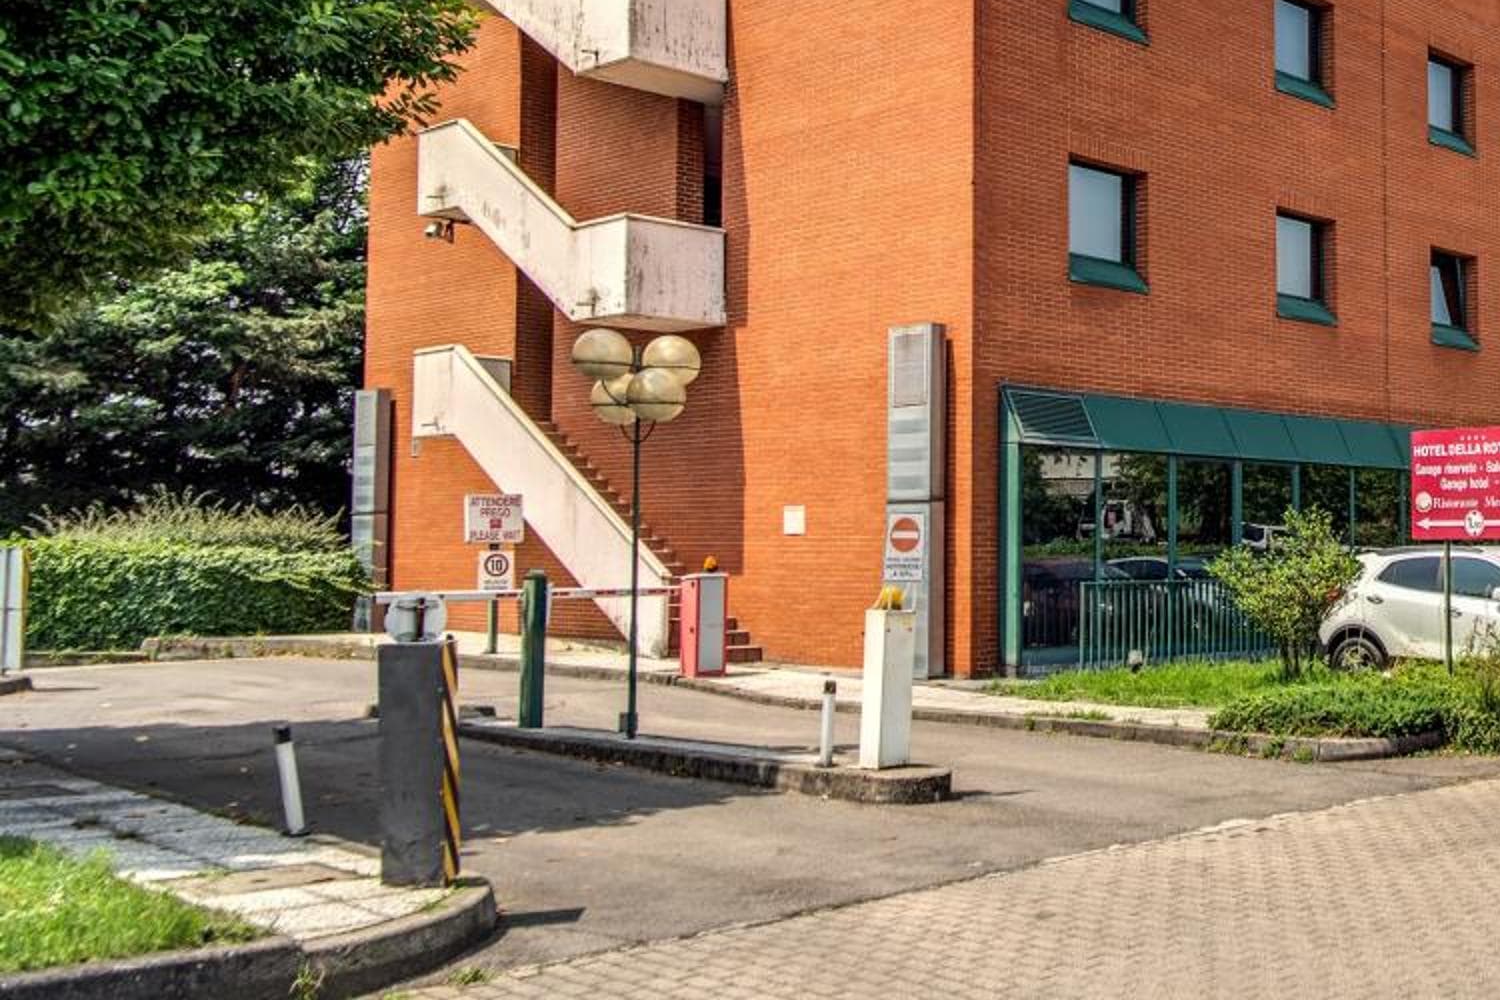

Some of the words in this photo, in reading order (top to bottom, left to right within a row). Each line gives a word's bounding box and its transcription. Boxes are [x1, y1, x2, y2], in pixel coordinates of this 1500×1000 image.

[1413, 443, 1447, 457] HOTEL
[1448, 442, 1481, 455] DELLA
[1470, 477, 1489, 488] hotel
[470, 495, 522, 507] ATTENDERE
[1433, 497, 1478, 509] Ristorante
[480, 507, 511, 518] PREGO
[470, 530, 500, 541] PLEASE
[503, 529, 521, 540] WAIT
[491, 559, 503, 571] 10
